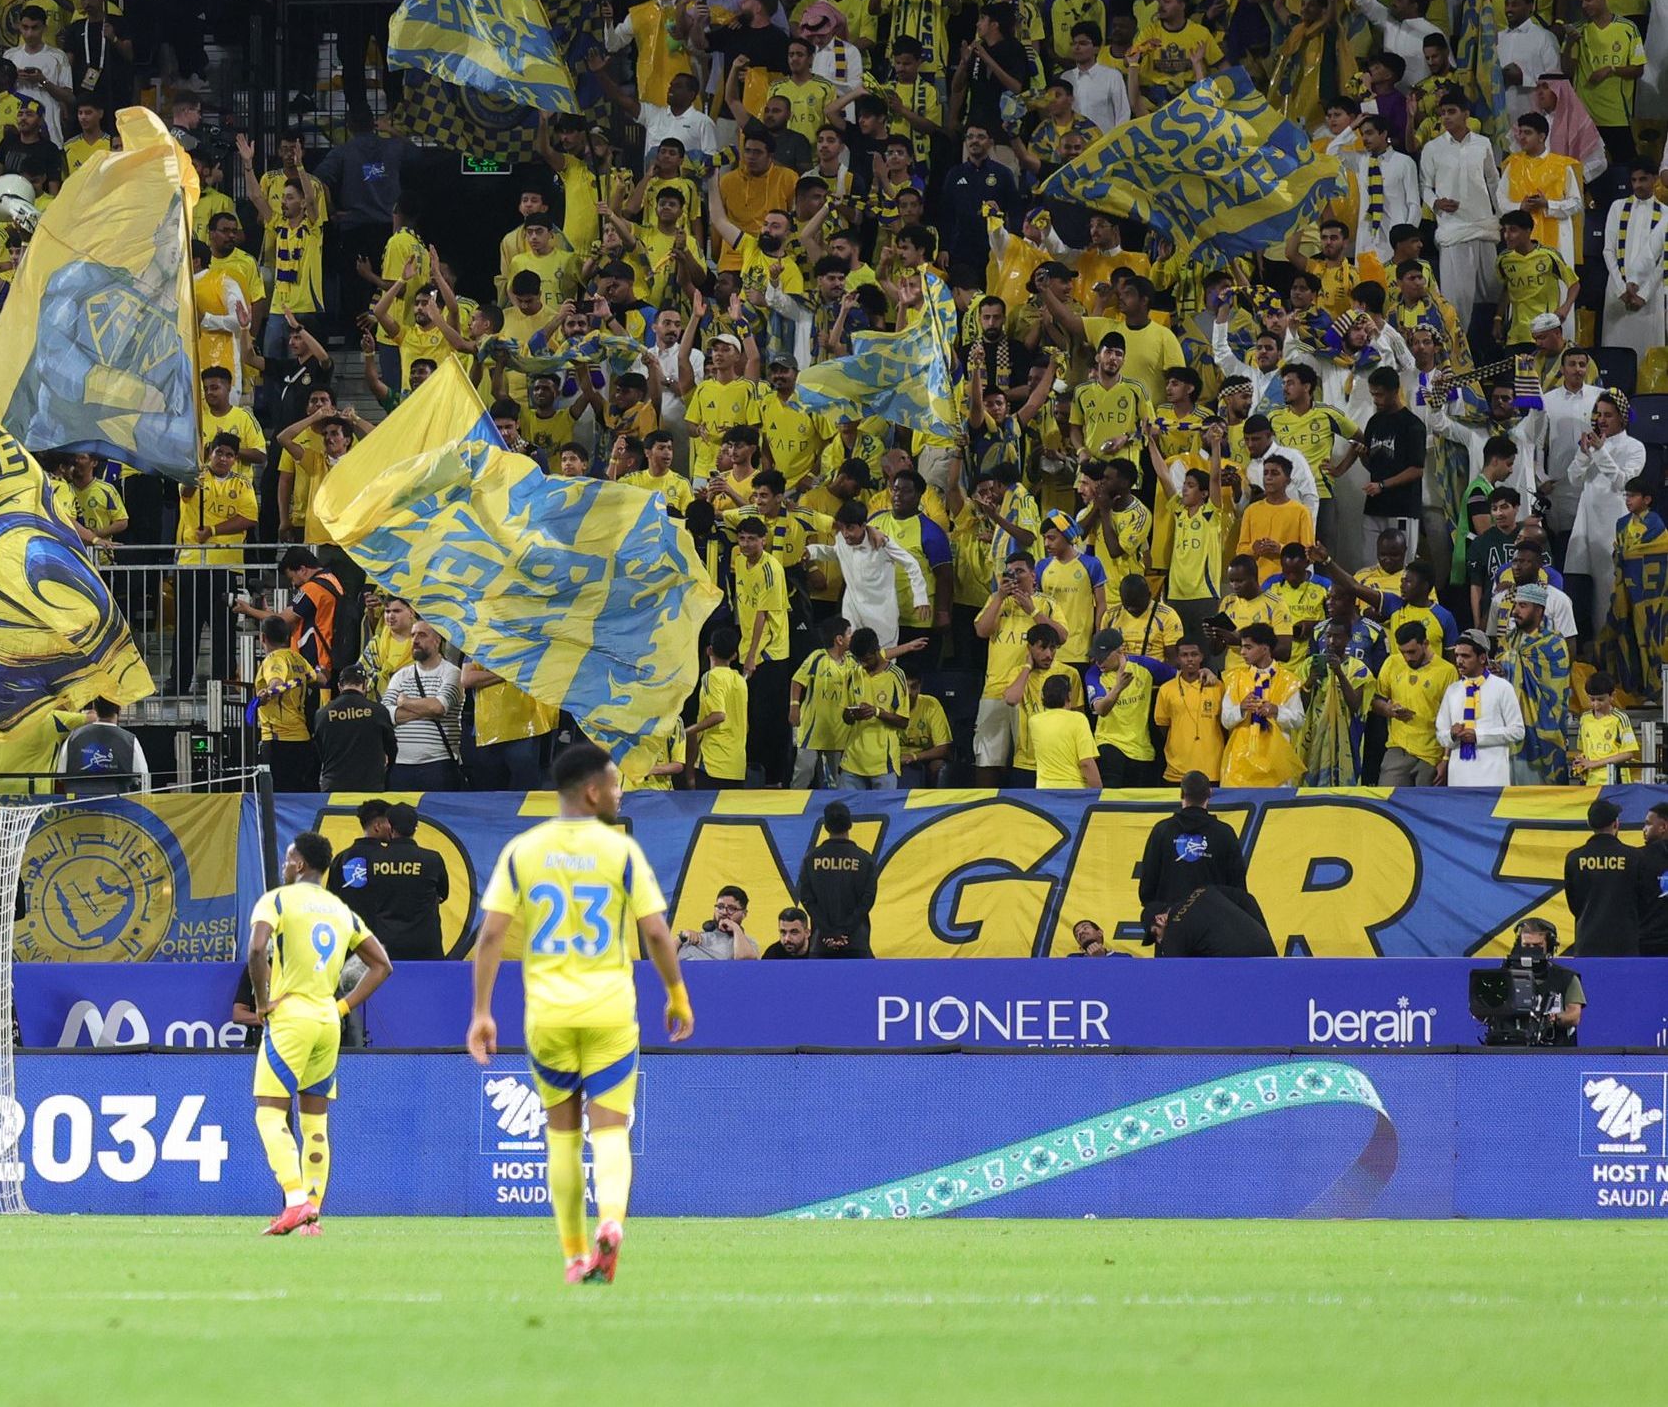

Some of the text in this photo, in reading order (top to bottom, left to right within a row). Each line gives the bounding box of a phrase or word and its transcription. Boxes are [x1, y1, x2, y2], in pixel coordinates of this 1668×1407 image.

[1591, 55, 1619, 65] AFD
[791, 114, 815, 123] AFD
[1508, 275, 1545, 287] KAFD
[545, 293, 563, 304] FD
[1089, 410, 1126, 423] KAFD
[1279, 433, 1320, 445] KAFD
[208, 502, 235, 515] AFD
[1181, 538, 1200, 550] FD
[737, 593, 757, 608] KAF
[994, 633, 1027, 644] KAF
[822, 690, 842, 700] KA
[328, 708, 373, 723] Police
[373, 862, 422, 877] POLICE
[814, 857, 860, 871] POLICE
[1579, 857, 1626, 871] POLICE
[527, 882, 611, 959] 23
[310, 922, 336, 971] 9
[878, 996, 1111, 1040] PIONEER
[1308, 997, 1431, 1043] berain
[493, 1161, 548, 1181] HOST
[1592, 1164, 1649, 1183] HOST
[1596, 1188, 1655, 1206] SAUDI
